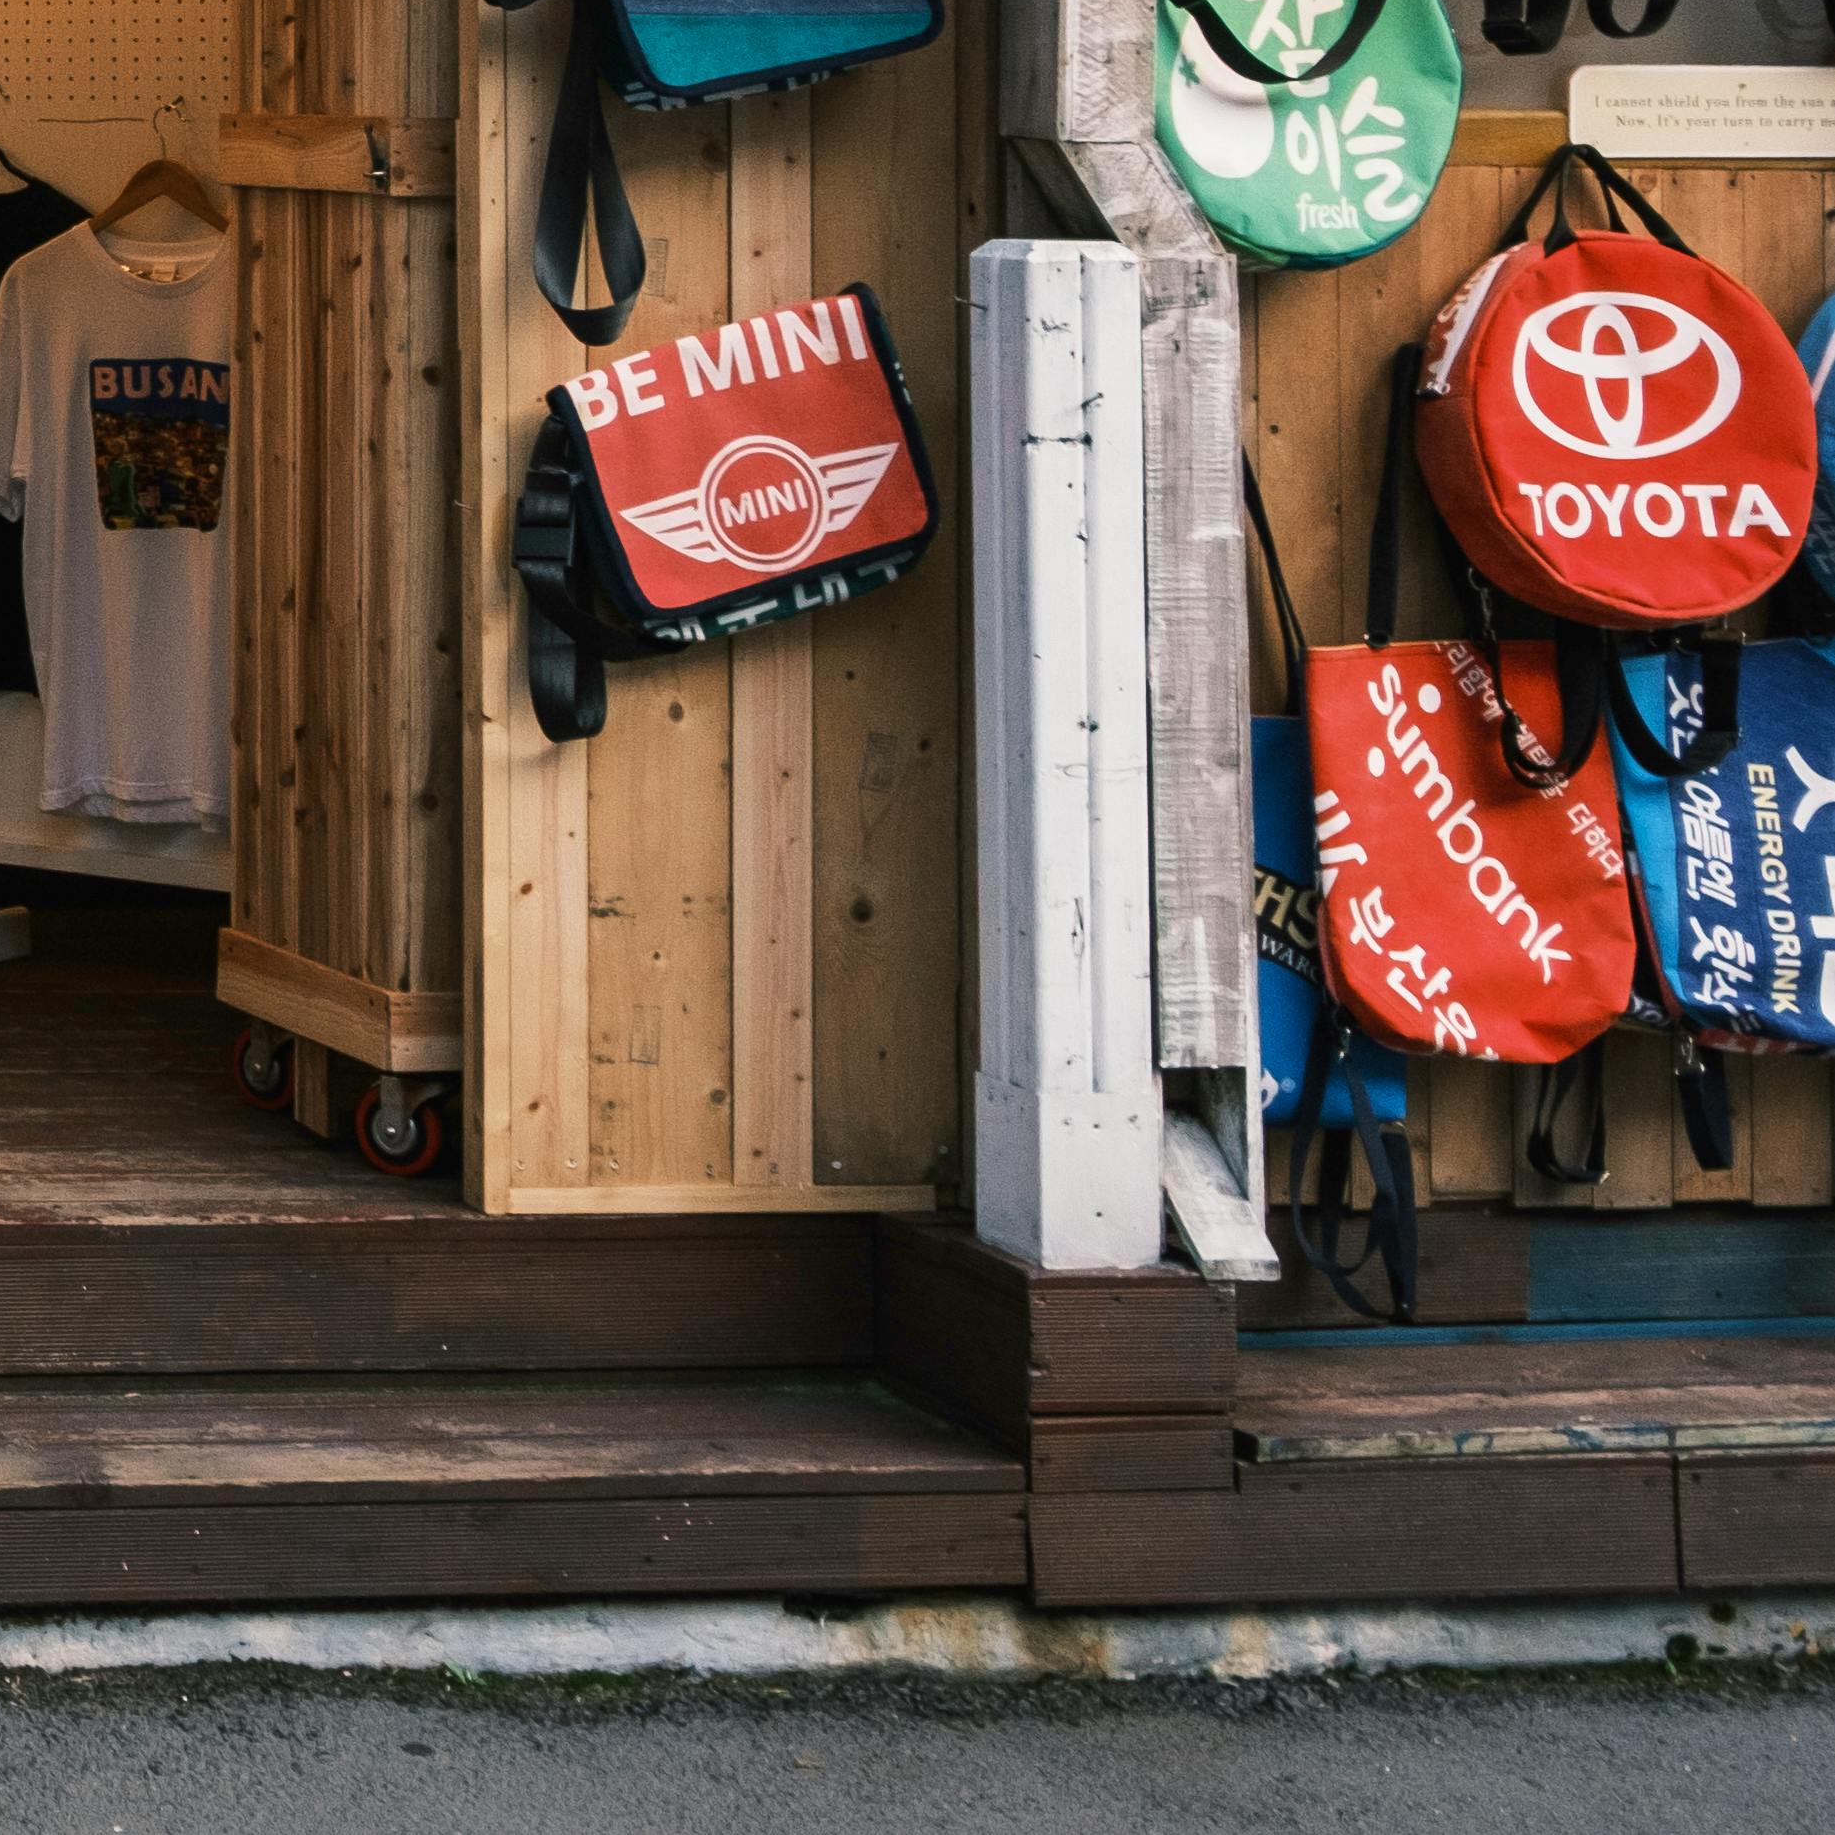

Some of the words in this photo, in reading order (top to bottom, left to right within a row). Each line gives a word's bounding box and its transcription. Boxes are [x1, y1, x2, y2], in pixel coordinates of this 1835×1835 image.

[1605, 95, 1652, 108] cannot
[1657, 95, 1700, 108] shield
[1705, 98, 1730, 110] you
[1735, 95, 1768, 108] from
[1774, 95, 1795, 108] the
[1615, 115, 1652, 129] Now,
[1686, 118, 1718, 130] your
[1723, 116, 1753, 128] turn
[1758, 116, 1773, 127] to
[1777, 118, 1814, 130] carry
[1296, 192, 1360, 232] fresh
[93, 365, 230, 405] BUSAN
[566, 350, 664, 432] BE
[676, 295, 869, 401] MINI
[720, 477, 811, 531] MINI
[1518, 481, 1792, 539] TOYOTA
[1747, 762, 1793, 905] ENERGY
[1765, 907, 1802, 1016] DRINK
